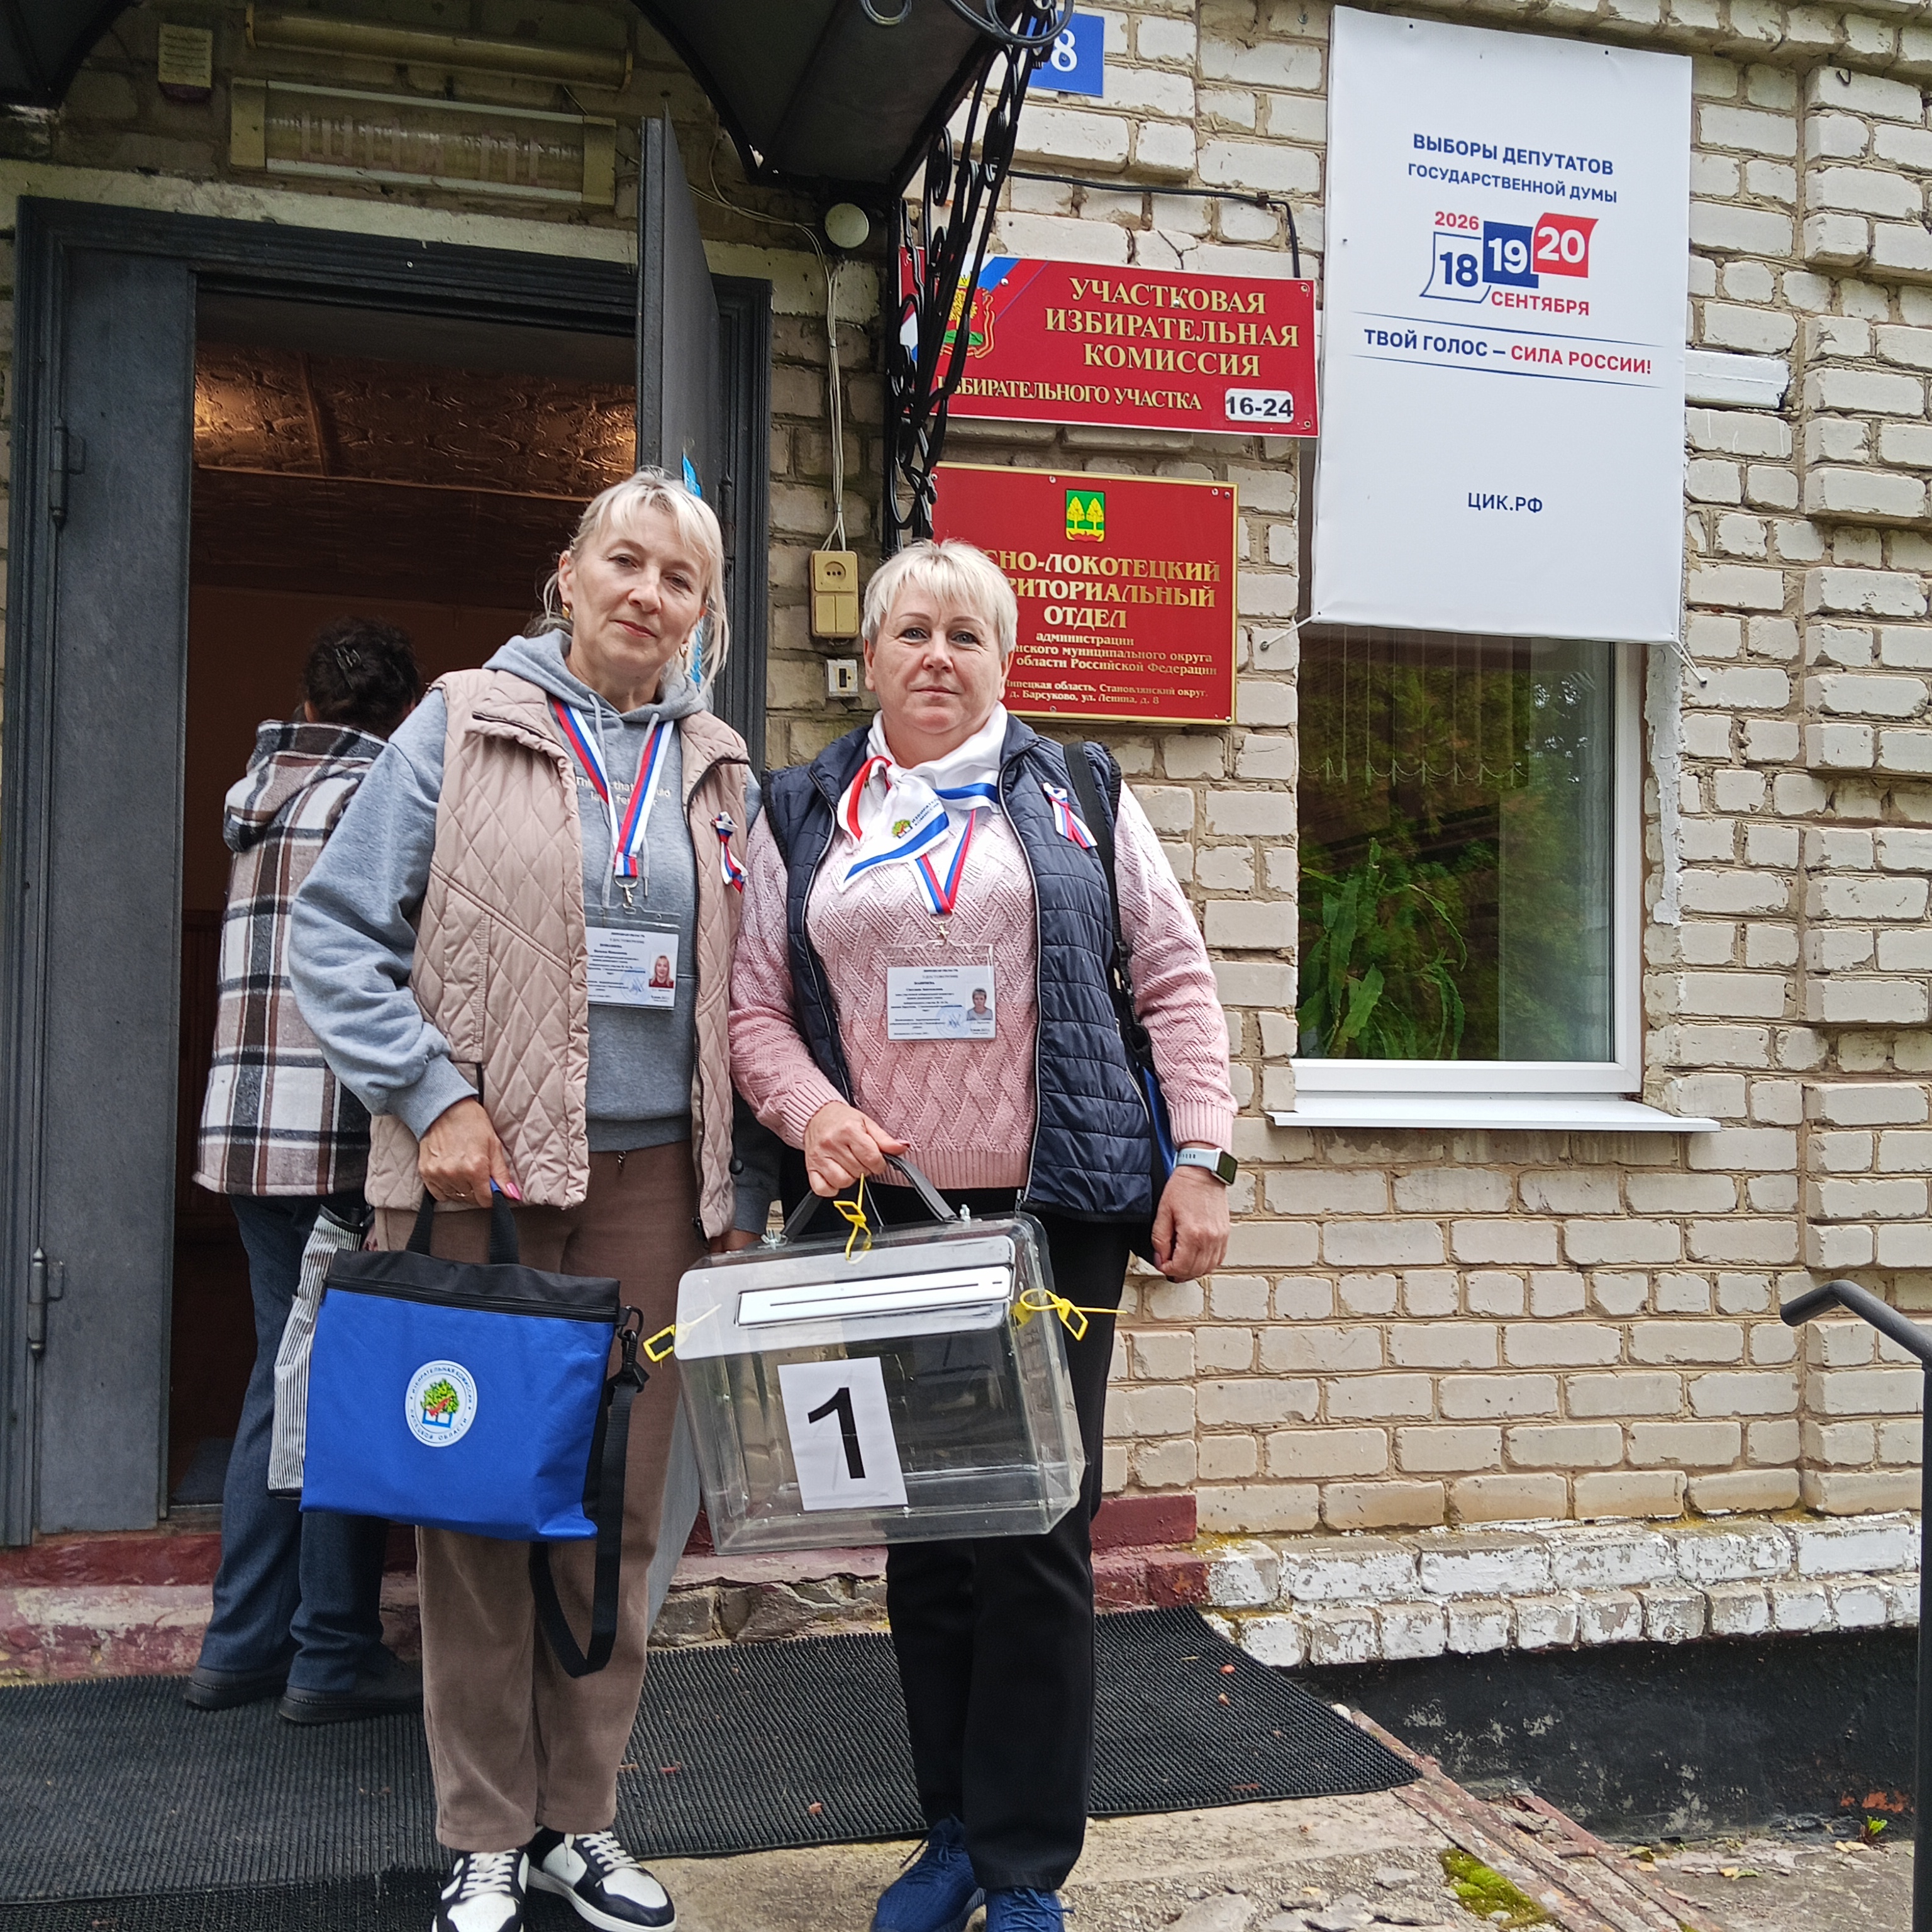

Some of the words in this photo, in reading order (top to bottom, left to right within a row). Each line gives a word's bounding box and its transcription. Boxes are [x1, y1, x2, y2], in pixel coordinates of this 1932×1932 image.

[1413, 133, 1497, 160] ВЫБОРЫ
[1503, 147, 1613, 175] ДЕПУТАТОВ
[1408, 163, 1565, 197] ГОСУДАРСТВЕННОЙ
[1570, 186, 1617, 203] ДУМЫ
[1435, 211, 1479, 230] 2026
[1440, 252, 1479, 287] 18
[1488, 237, 1528, 274] 19
[1537, 226, 1585, 264] 20
[1069, 277, 1266, 314] УЧАСТКОВАЯ
[1491, 291, 1589, 316] СЕНТЯБРЯ
[1045, 308, 1299, 347] ИЗБИРАТЕЛЬНАЯ
[1083, 343, 1261, 377] КОМИССИЯ
[1364, 329, 1417, 350] ТВОЙ
[1423, 336, 1487, 357] ГОЛОС
[1511, 345, 1562, 365] СИЛА
[1569, 352, 1651, 374] РОССИИ!
[937, 375, 1110, 404] БИРАТЕЛЬНОГО
[1113, 387, 1202, 411] УЧАСТКА
[1226, 396, 1294, 418] 16-24
[1468, 492, 1543, 513] ЦИК.РФ
[1044, 605, 1127, 631] ОТДЕЛ
[1016, 645, 1059, 655] нского
[1062, 647, 1167, 660] муниципального
[1170, 652, 1213, 664] округа
[1036, 633, 1135, 647] администрации
[1016, 655, 1067, 668] области
[1070, 658, 1144, 672] Российской
[1147, 662, 1217, 676] Федерации
[808, 1387, 865, 1479] 1
